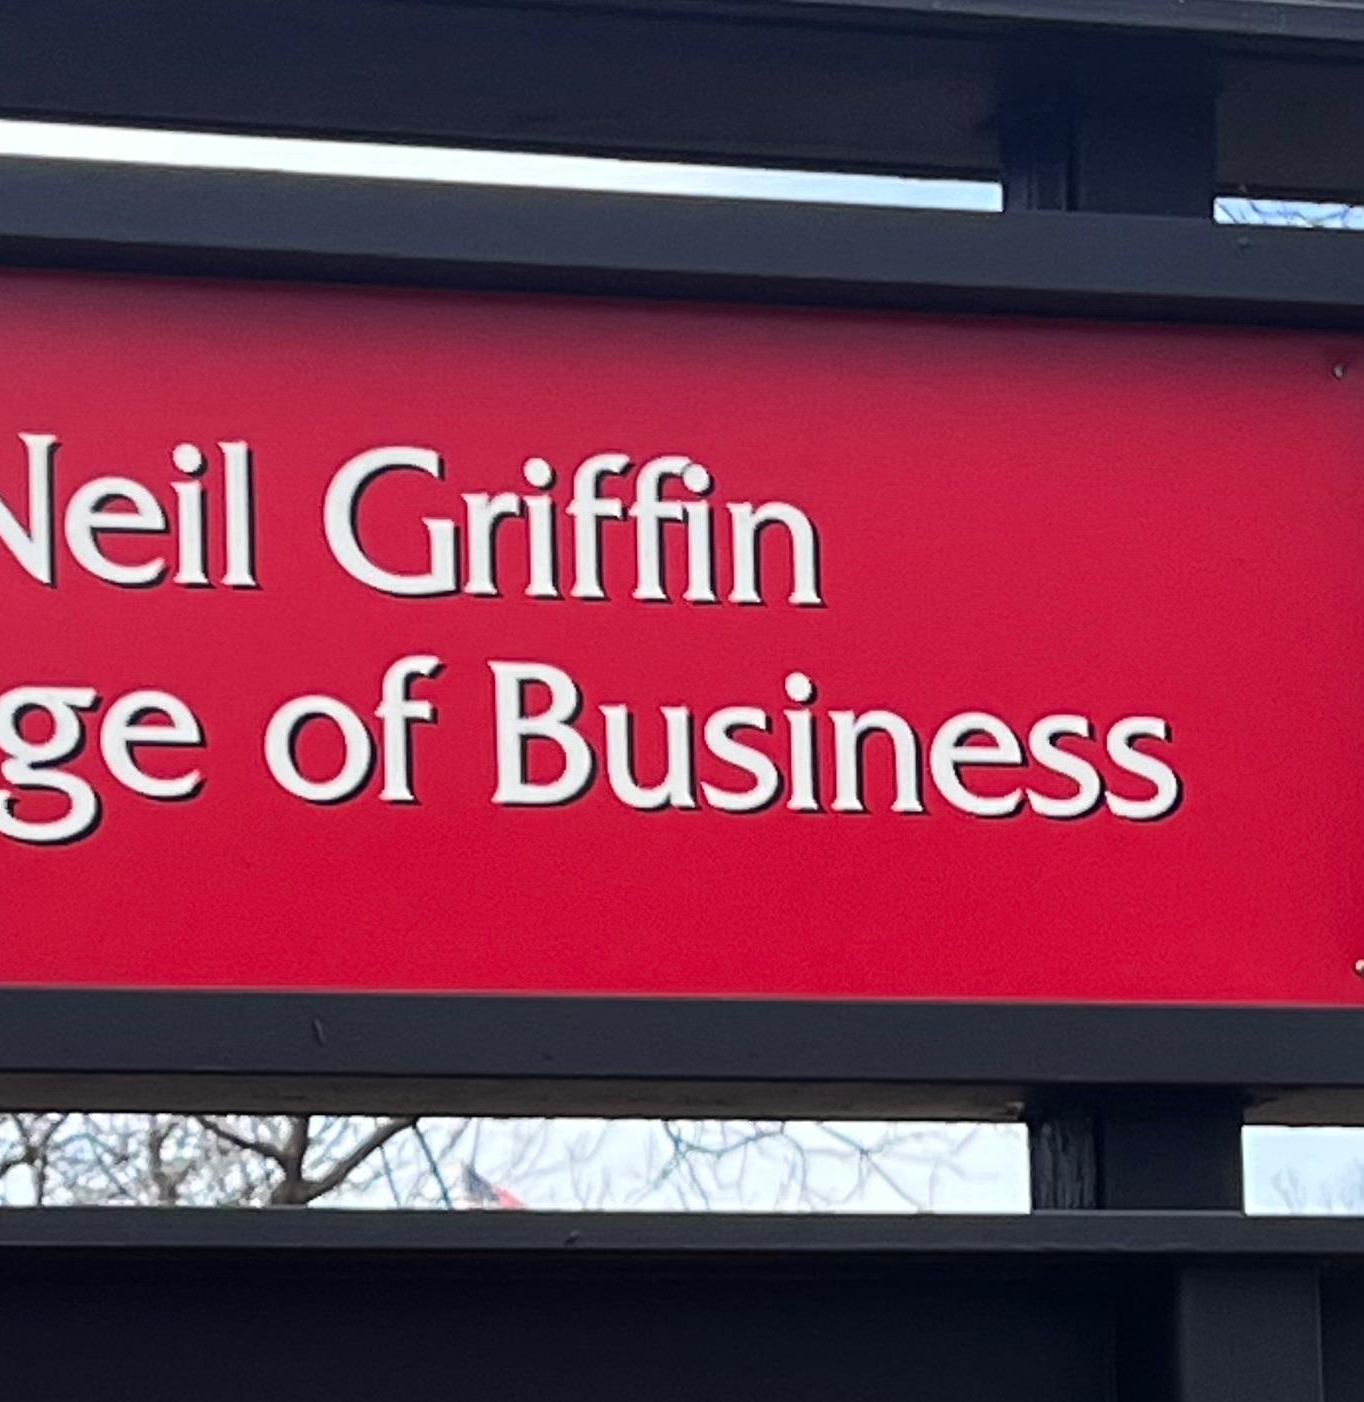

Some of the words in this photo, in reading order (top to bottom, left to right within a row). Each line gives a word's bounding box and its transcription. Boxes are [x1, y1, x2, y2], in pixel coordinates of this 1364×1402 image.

[322, 444, 827, 607] Griffin
[263, 654, 444, 806] of
[487, 659, 1182, 821] Business
